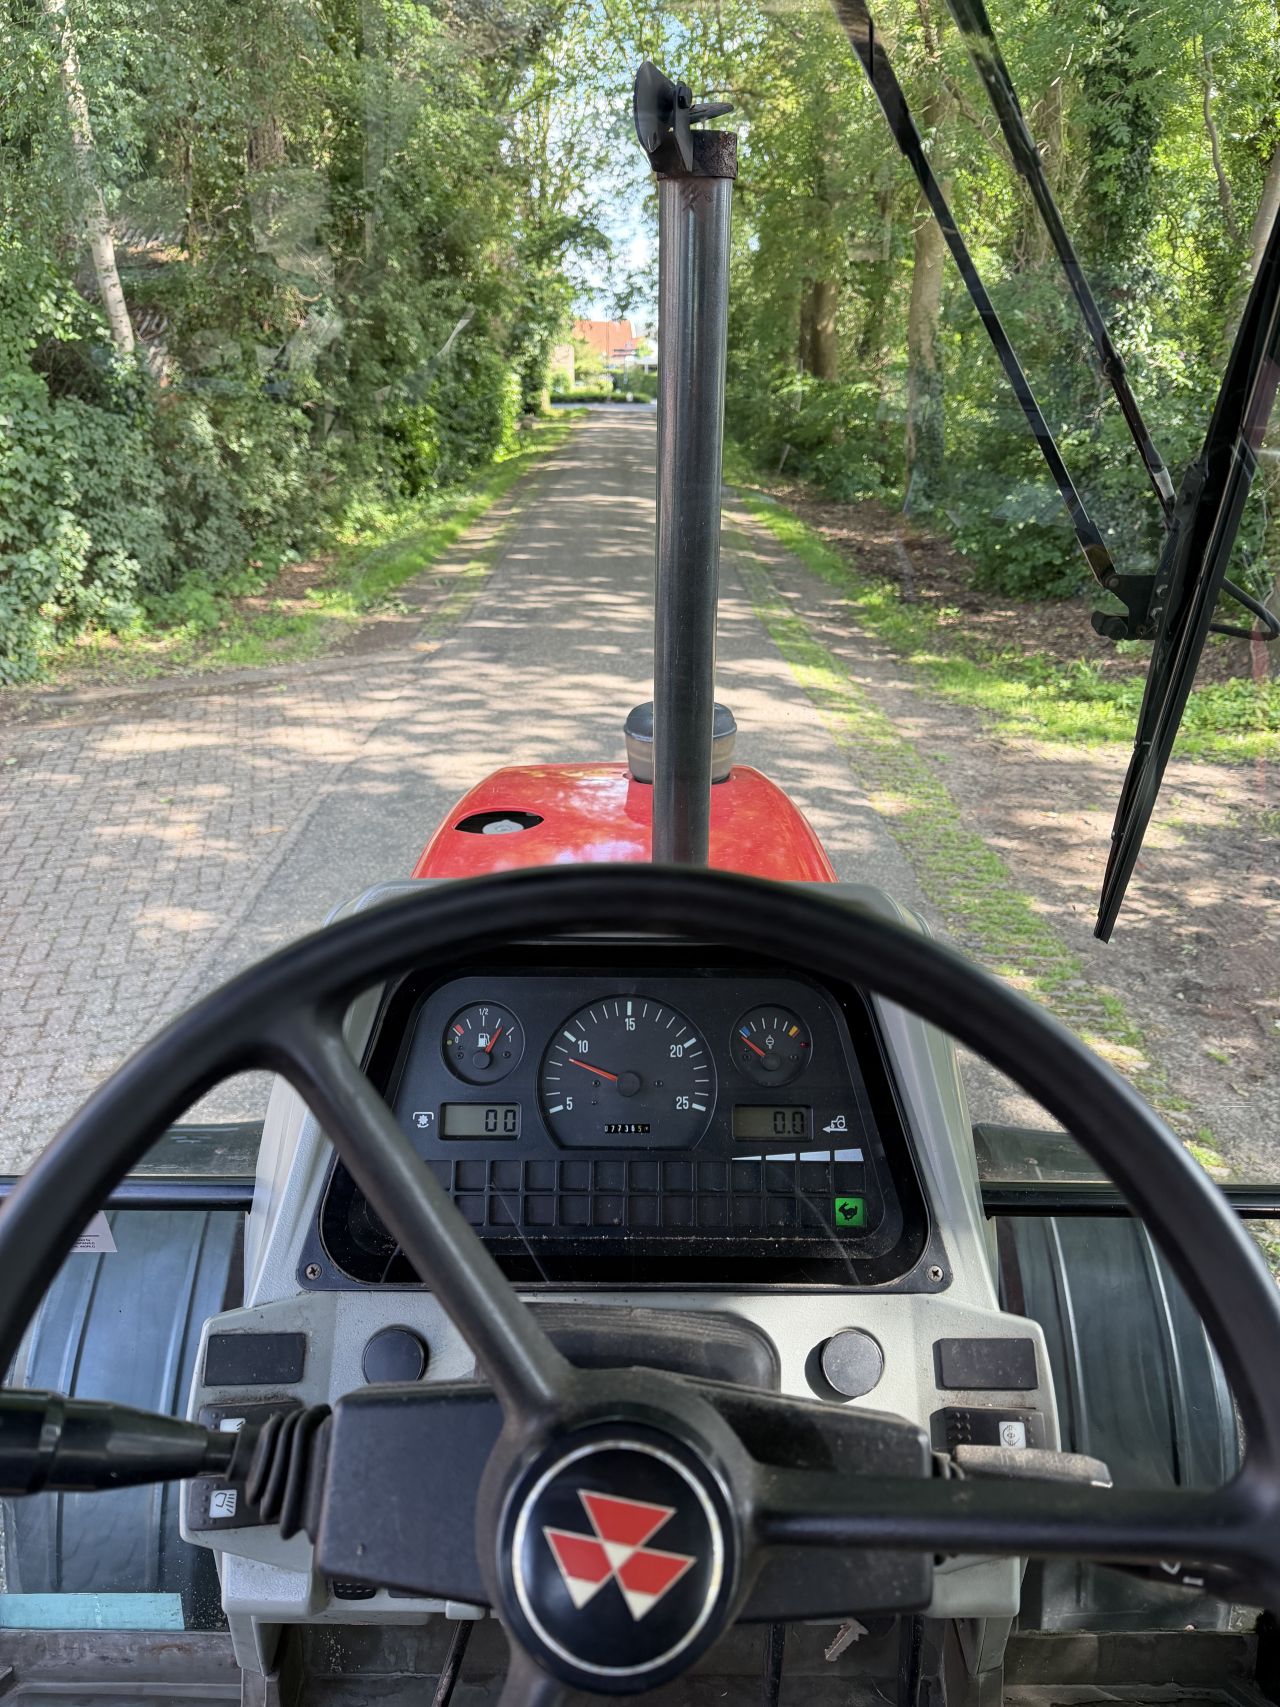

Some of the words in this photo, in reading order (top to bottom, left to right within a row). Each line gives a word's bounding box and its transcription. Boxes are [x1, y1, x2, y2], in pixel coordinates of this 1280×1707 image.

[478, 1008, 489, 1016] 1/2
[624, 1018, 636, 1030] 15
[577, 1040, 589, 1054] 10
[670, 1044, 683, 1058] 20
[566, 1096, 573, 1110] 5
[676, 1096, 689, 1110] 25
[773, 1110, 805, 1134] 0.0
